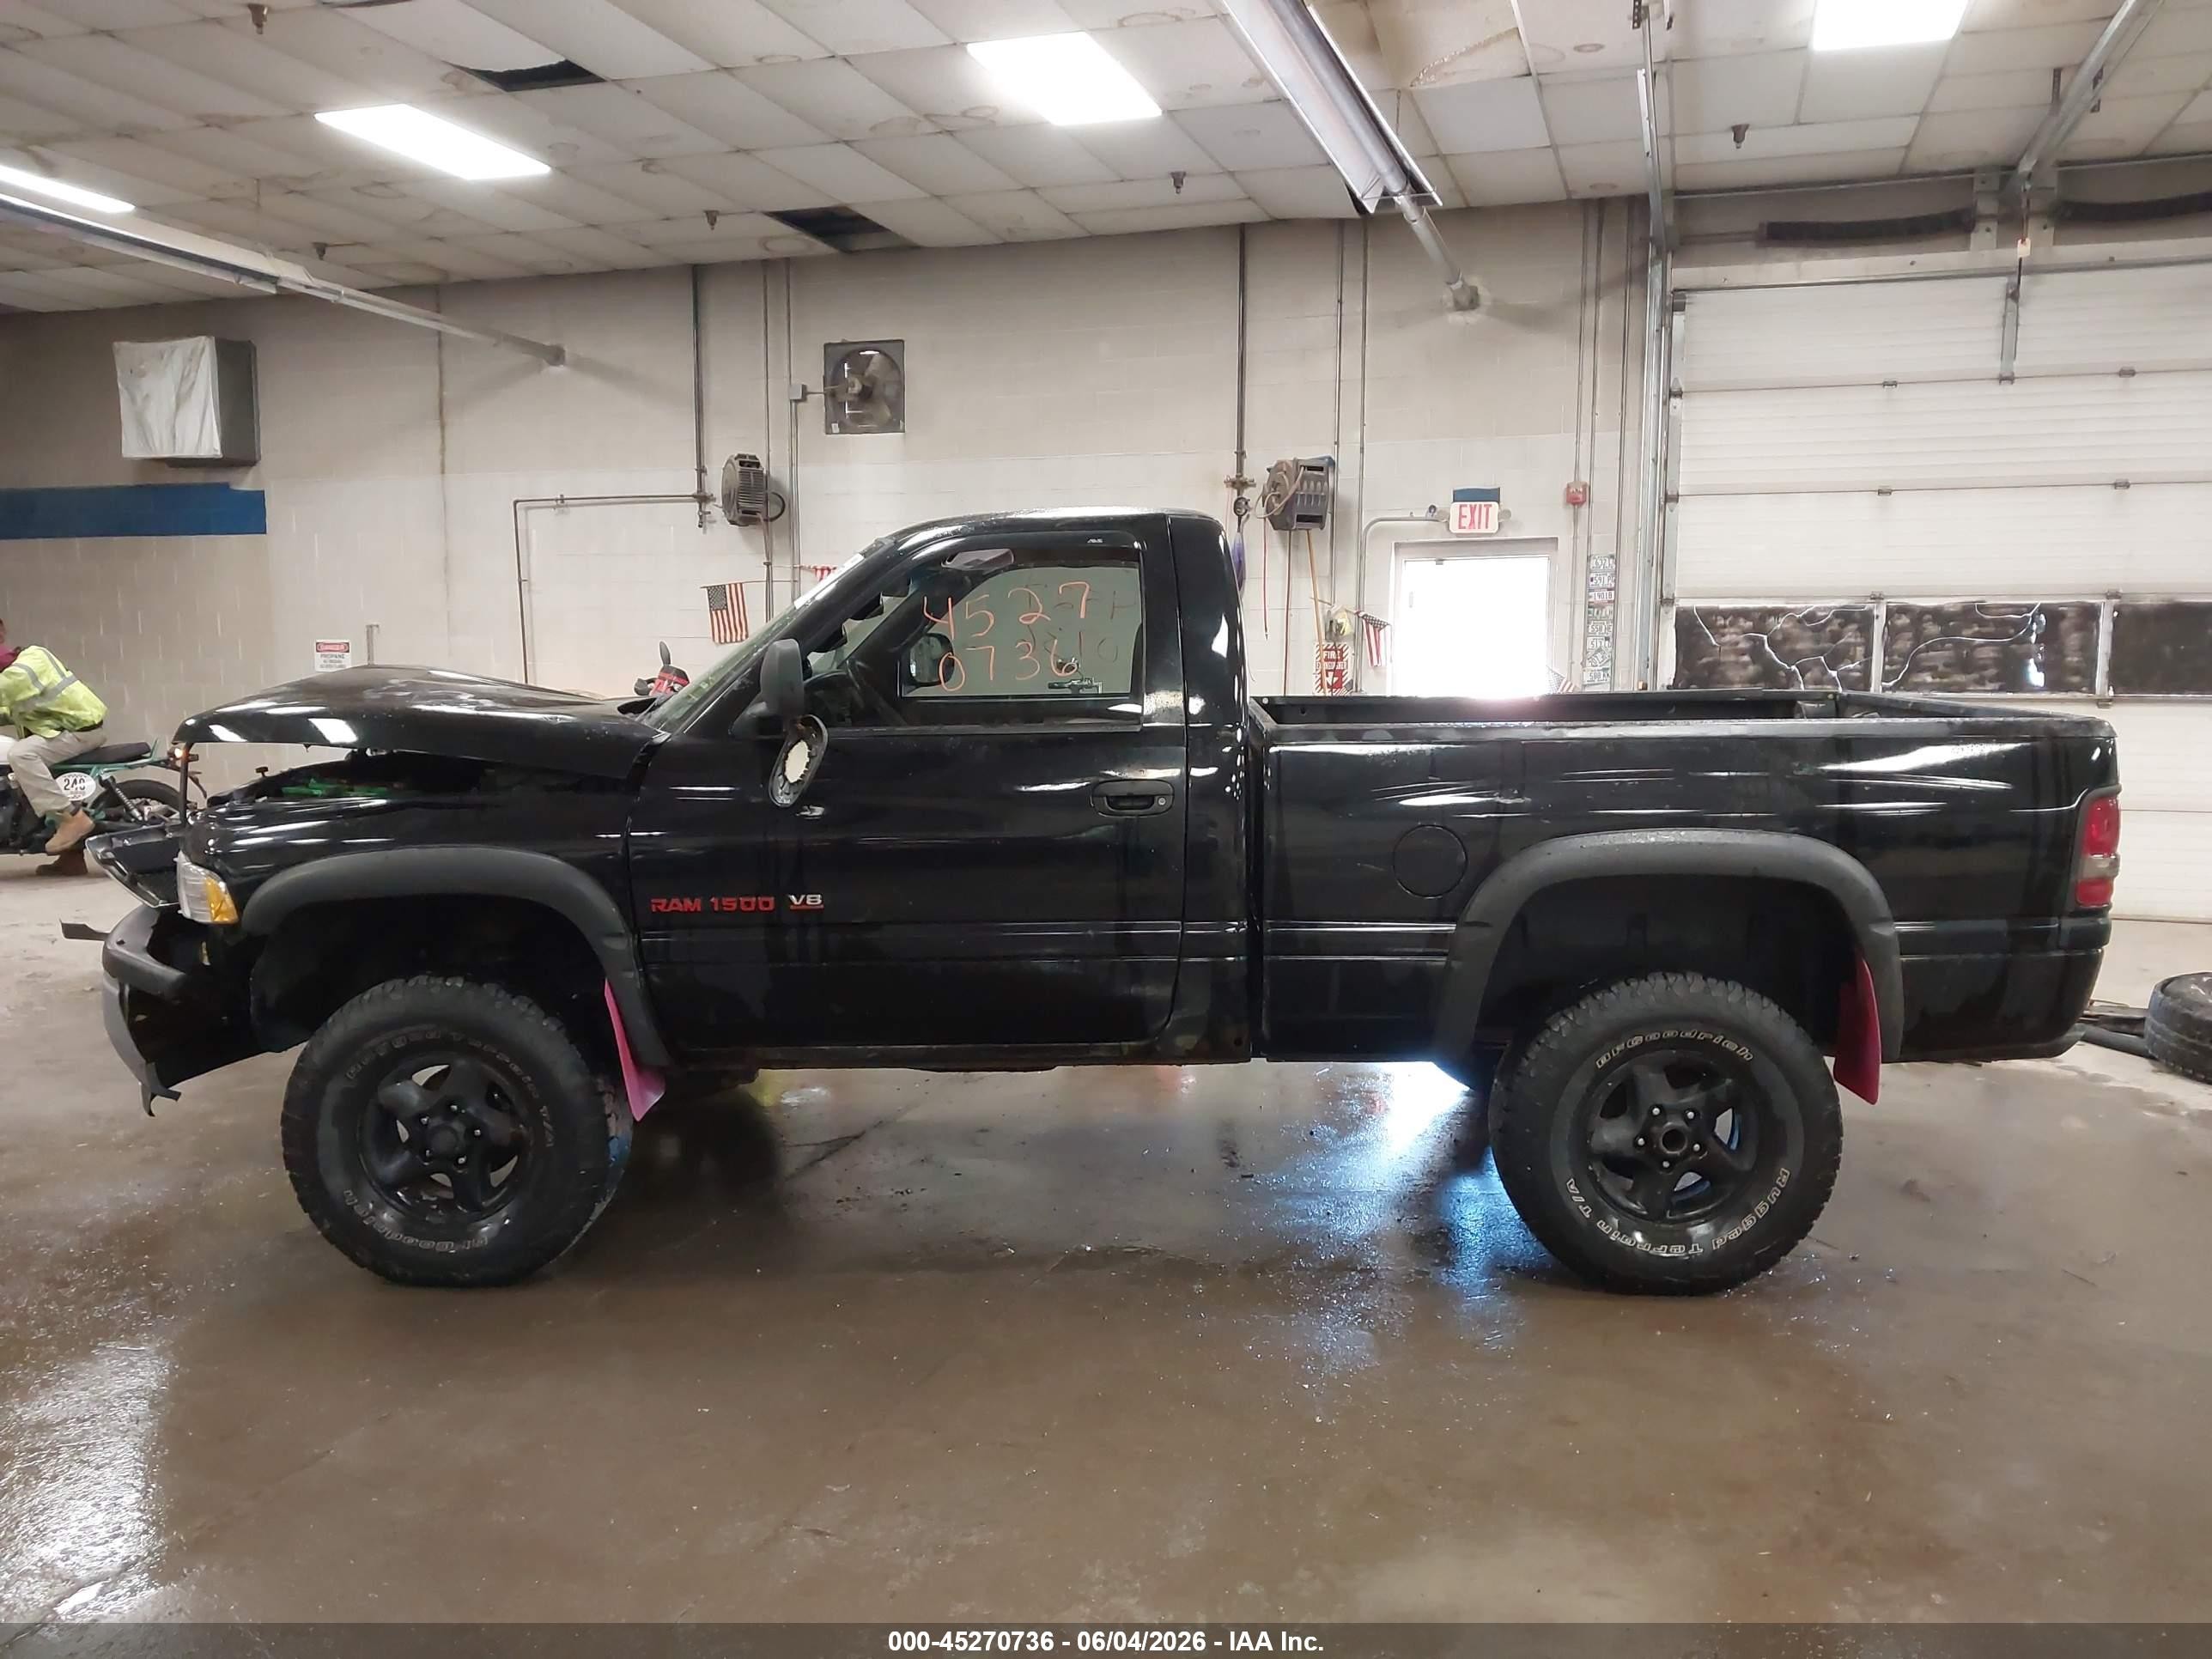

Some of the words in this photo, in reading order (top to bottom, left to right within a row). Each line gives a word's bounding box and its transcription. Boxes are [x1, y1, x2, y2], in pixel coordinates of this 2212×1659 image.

[1458, 504, 1492, 530] EXIT
[923, 580, 1091, 641] 4527
[938, 638, 1079, 692] 0736
[651, 897, 702, 913] RAM
[709, 896, 775, 912] 1500
[787, 894, 823, 907] V8
[1712, 1168, 1790, 1250] Rugged
[1596, 1219, 1704, 1255] Terrain
